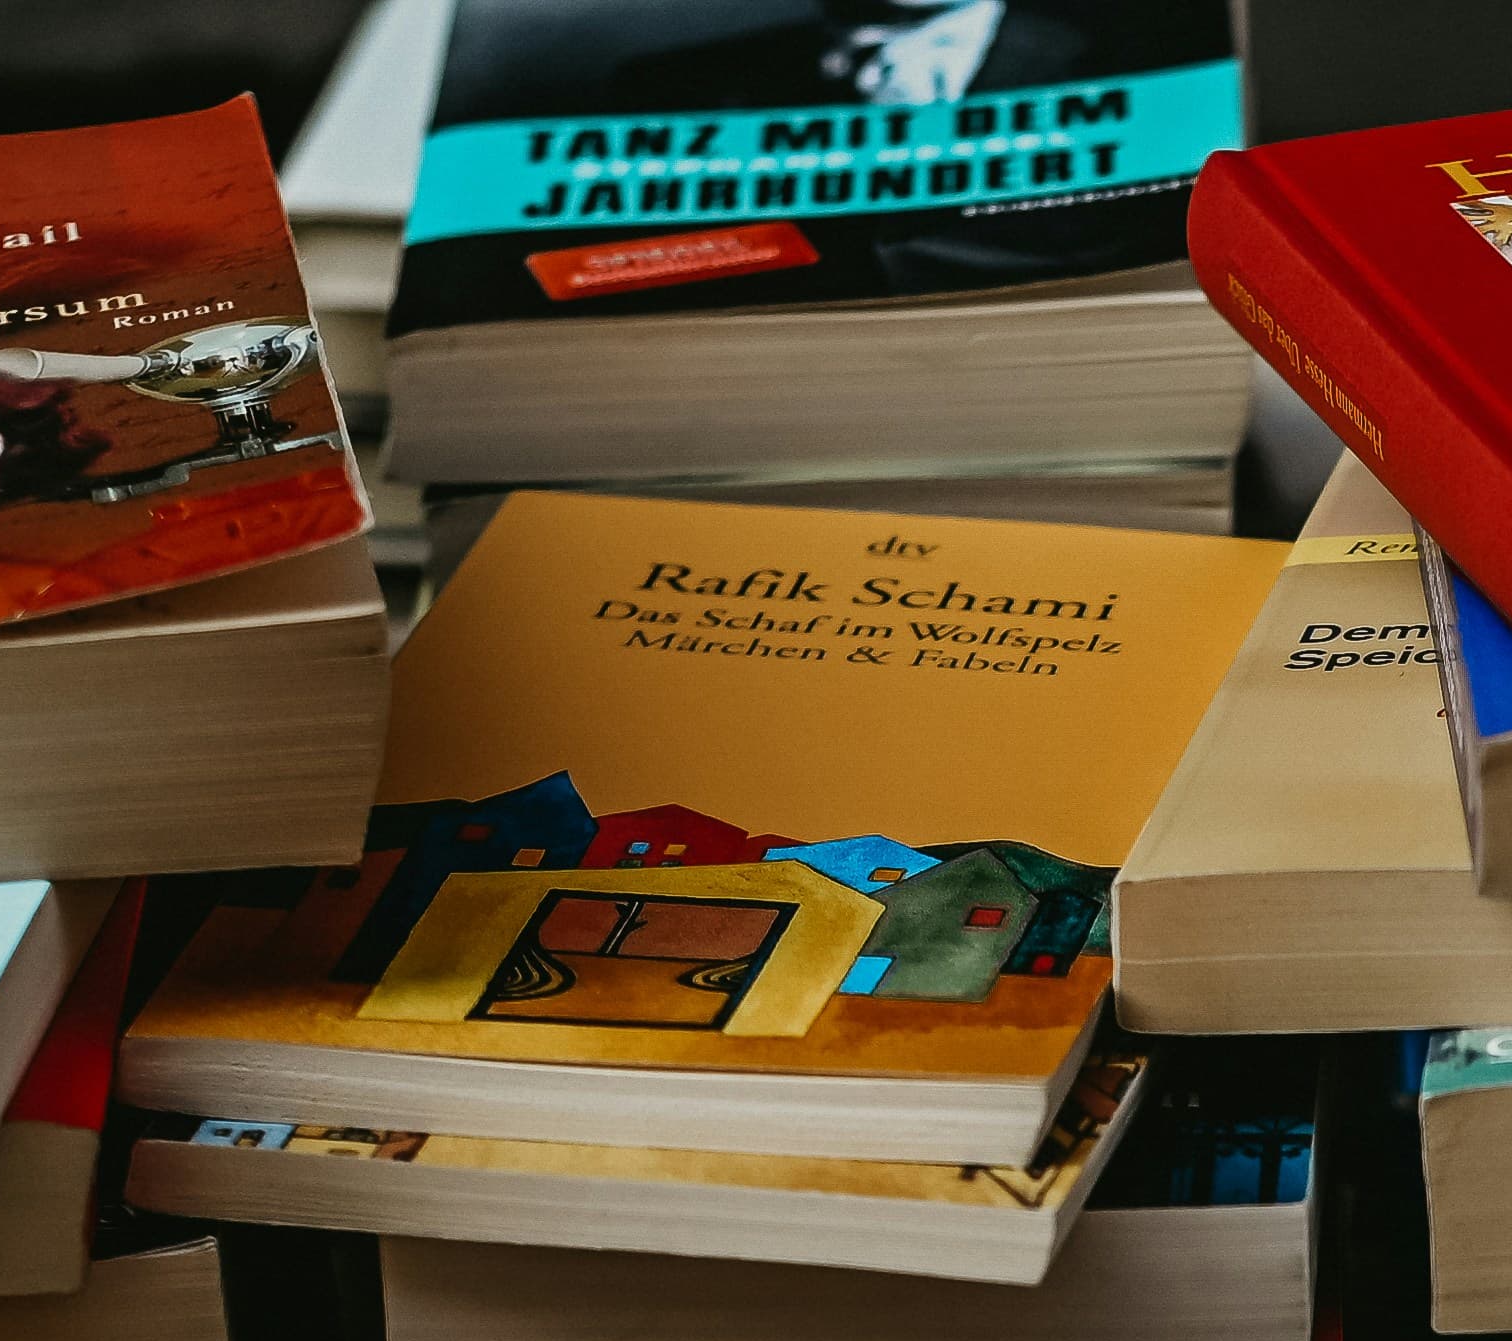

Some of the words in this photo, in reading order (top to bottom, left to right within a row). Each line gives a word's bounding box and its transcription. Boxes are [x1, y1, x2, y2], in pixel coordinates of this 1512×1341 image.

[527, 124, 723, 164] TANZ
[760, 110, 915, 153] MIT
[955, 86, 1131, 136] DEM
[522, 142, 1122, 219] JAHRHUNDERT
[112, 298, 237, 330] Roman
[1304, 354, 1335, 408] Hesse
[1335, 386, 1384, 462] Hermann
[864, 535, 941, 559] dtv
[637, 560, 832, 604] Rafik
[851, 576, 1121, 621] Schami
[593, 599, 682, 626] Das
[695, 606, 833, 635] Schaf
[834, 616, 894, 641] im
[908, 620, 1124, 656] Wolfspelz
[623, 628, 828, 662] Märchen
[846, 644, 889, 667] &
[908, 647, 1061, 678] Fabeln
[1299, 622, 1432, 645] Dem
